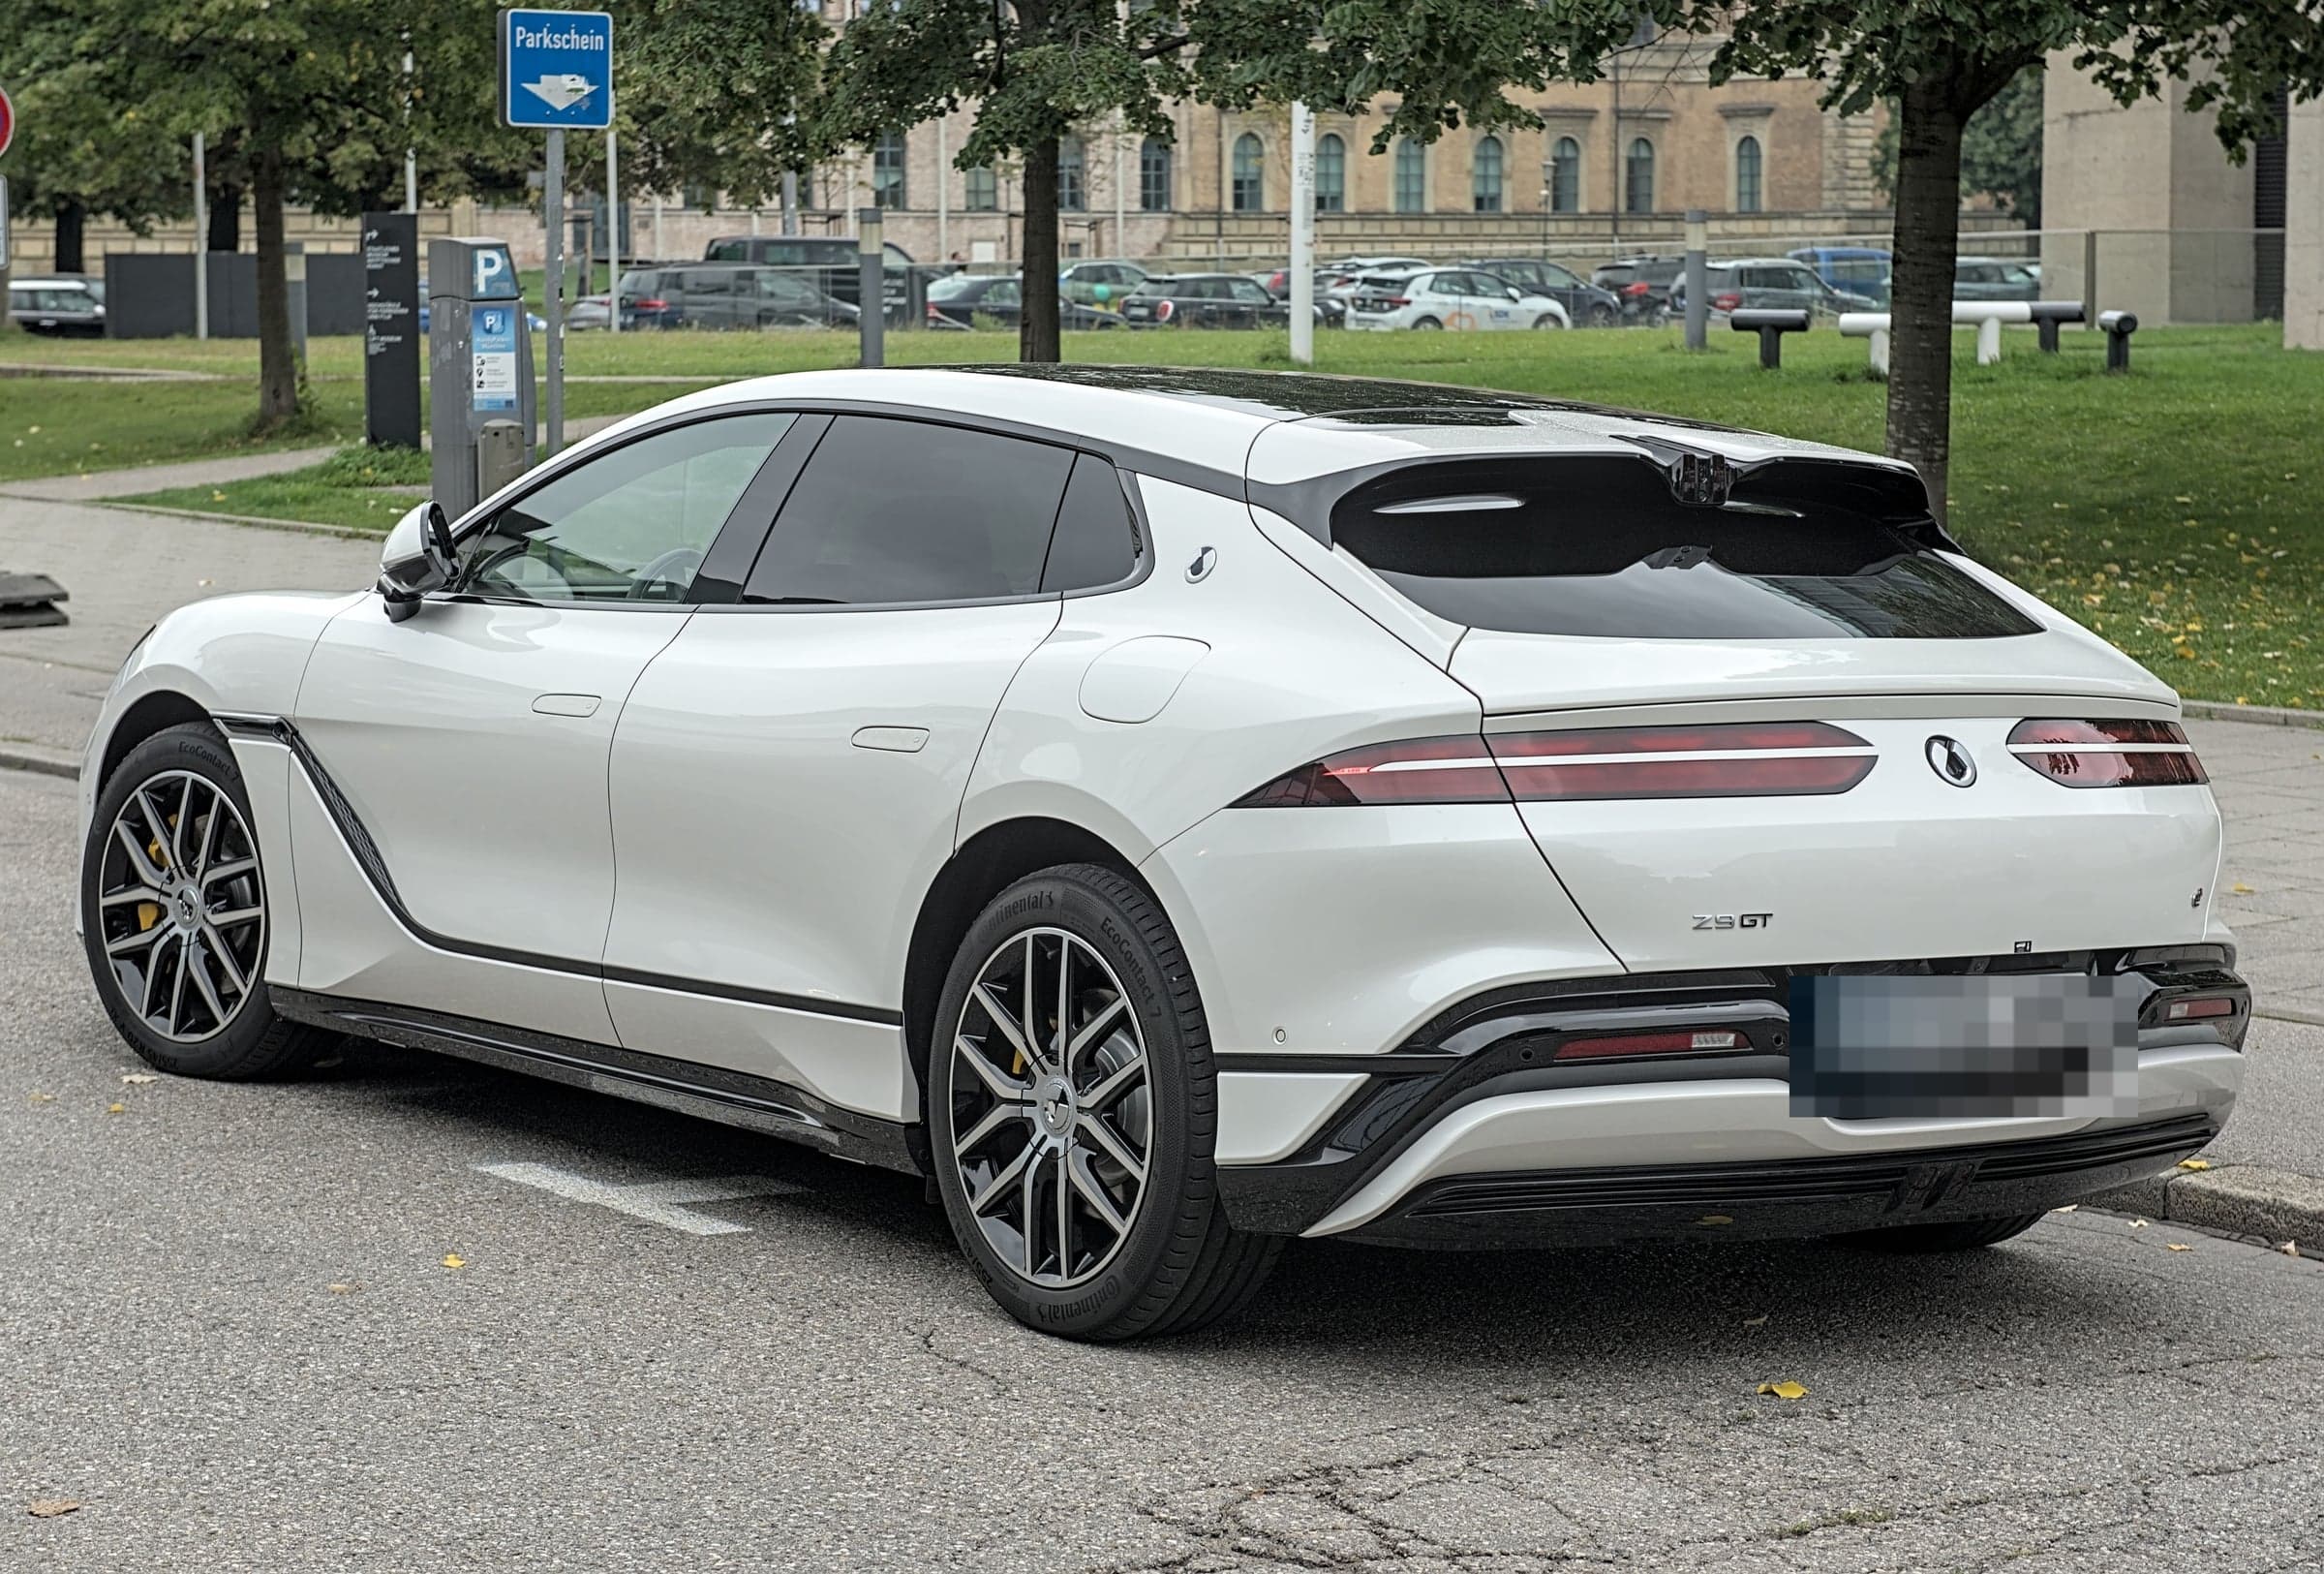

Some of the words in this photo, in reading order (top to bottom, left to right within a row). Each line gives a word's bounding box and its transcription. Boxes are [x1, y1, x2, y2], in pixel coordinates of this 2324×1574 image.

[515, 25, 604, 51] Parkschein
[477, 249, 503, 293] P
[178, 740, 231, 775] EcoContact
[1100, 916, 1155, 1006] EcoContact
[1148, 1005, 1163, 1018] 7
[1050, 1274, 1121, 1324] Continental
